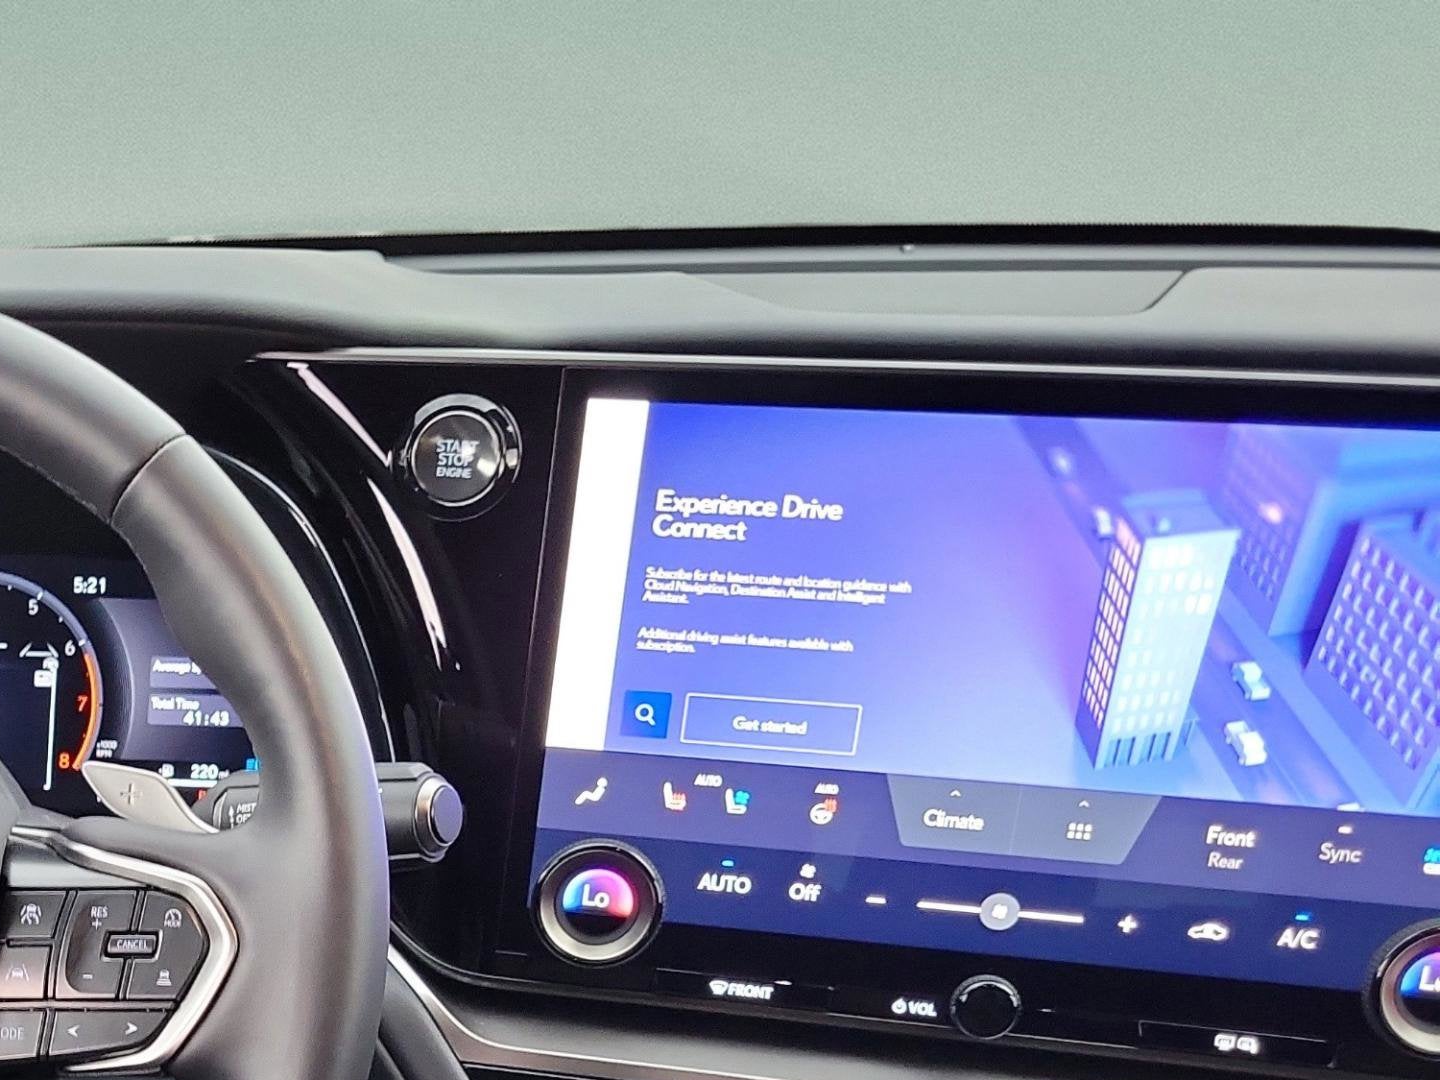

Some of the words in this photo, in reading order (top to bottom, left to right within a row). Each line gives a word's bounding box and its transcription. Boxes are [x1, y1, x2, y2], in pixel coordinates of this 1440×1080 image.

[436, 439, 480, 453] START
[437, 452, 475, 467] STOP
[436, 466, 472, 479] ENGINE
[655, 488, 778, 518] Experience
[781, 493, 844, 521] Drive
[652, 513, 748, 541] Connect
[73, 576, 107, 594] 5:21
[645, 566, 693, 580] Subscribe
[693, 569, 708, 581] for
[709, 570, 726, 582] the
[727, 571, 753, 584] latest
[754, 575, 782, 586] route
[782, 575, 802, 587] and
[803, 575, 842, 589] location
[842, 578, 887, 592] guidance
[888, 580, 912, 593] with
[642, 590, 690, 605] Assistant.
[644, 579, 675, 591] Cloud
[675, 580, 729, 596] Navigation,
[730, 583, 786, 599] Destination
[786, 587, 816, 600] Assist
[817, 589, 836, 601] and
[837, 589, 886, 606] Intelligent
[28, 598, 39, 615] 5
[636, 640, 696, 653] subscription.
[637, 626, 687, 642] Additional
[687, 629, 720, 645] driving
[720, 633, 746, 645] assist
[747, 633, 787, 648] features
[788, 637, 830, 650] available
[830, 640, 854, 652] with
[64, 640, 76, 656] 6
[151, 659, 191, 675] Average
[76, 695, 88, 712] 7
[150, 696, 174, 710] Total
[175, 697, 200, 711] Time
[183, 710, 230, 726] 41:43
[732, 715, 759, 731] Get
[760, 720, 808, 735] started
[58, 752, 70, 769] 8
[190, 763, 219, 779] 220
[693, 773, 723, 787] AUTO
[814, 782, 840, 795] AUTO
[236, 802, 257, 814] MIST
[923, 808, 985, 831] Climate
[1205, 824, 1257, 848] Front
[1207, 851, 1244, 870] Rear
[1318, 841, 1363, 865] Sync
[696, 872, 752, 894] AUTO
[582, 883, 610, 908] Lo
[788, 881, 822, 903] Off
[90, 906, 109, 919] RES
[116, 938, 148, 951] CANCEL
[1276, 927, 1321, 951] A/C
[726, 982, 774, 1001] FRONT
[908, 1000, 938, 1018] VOL
